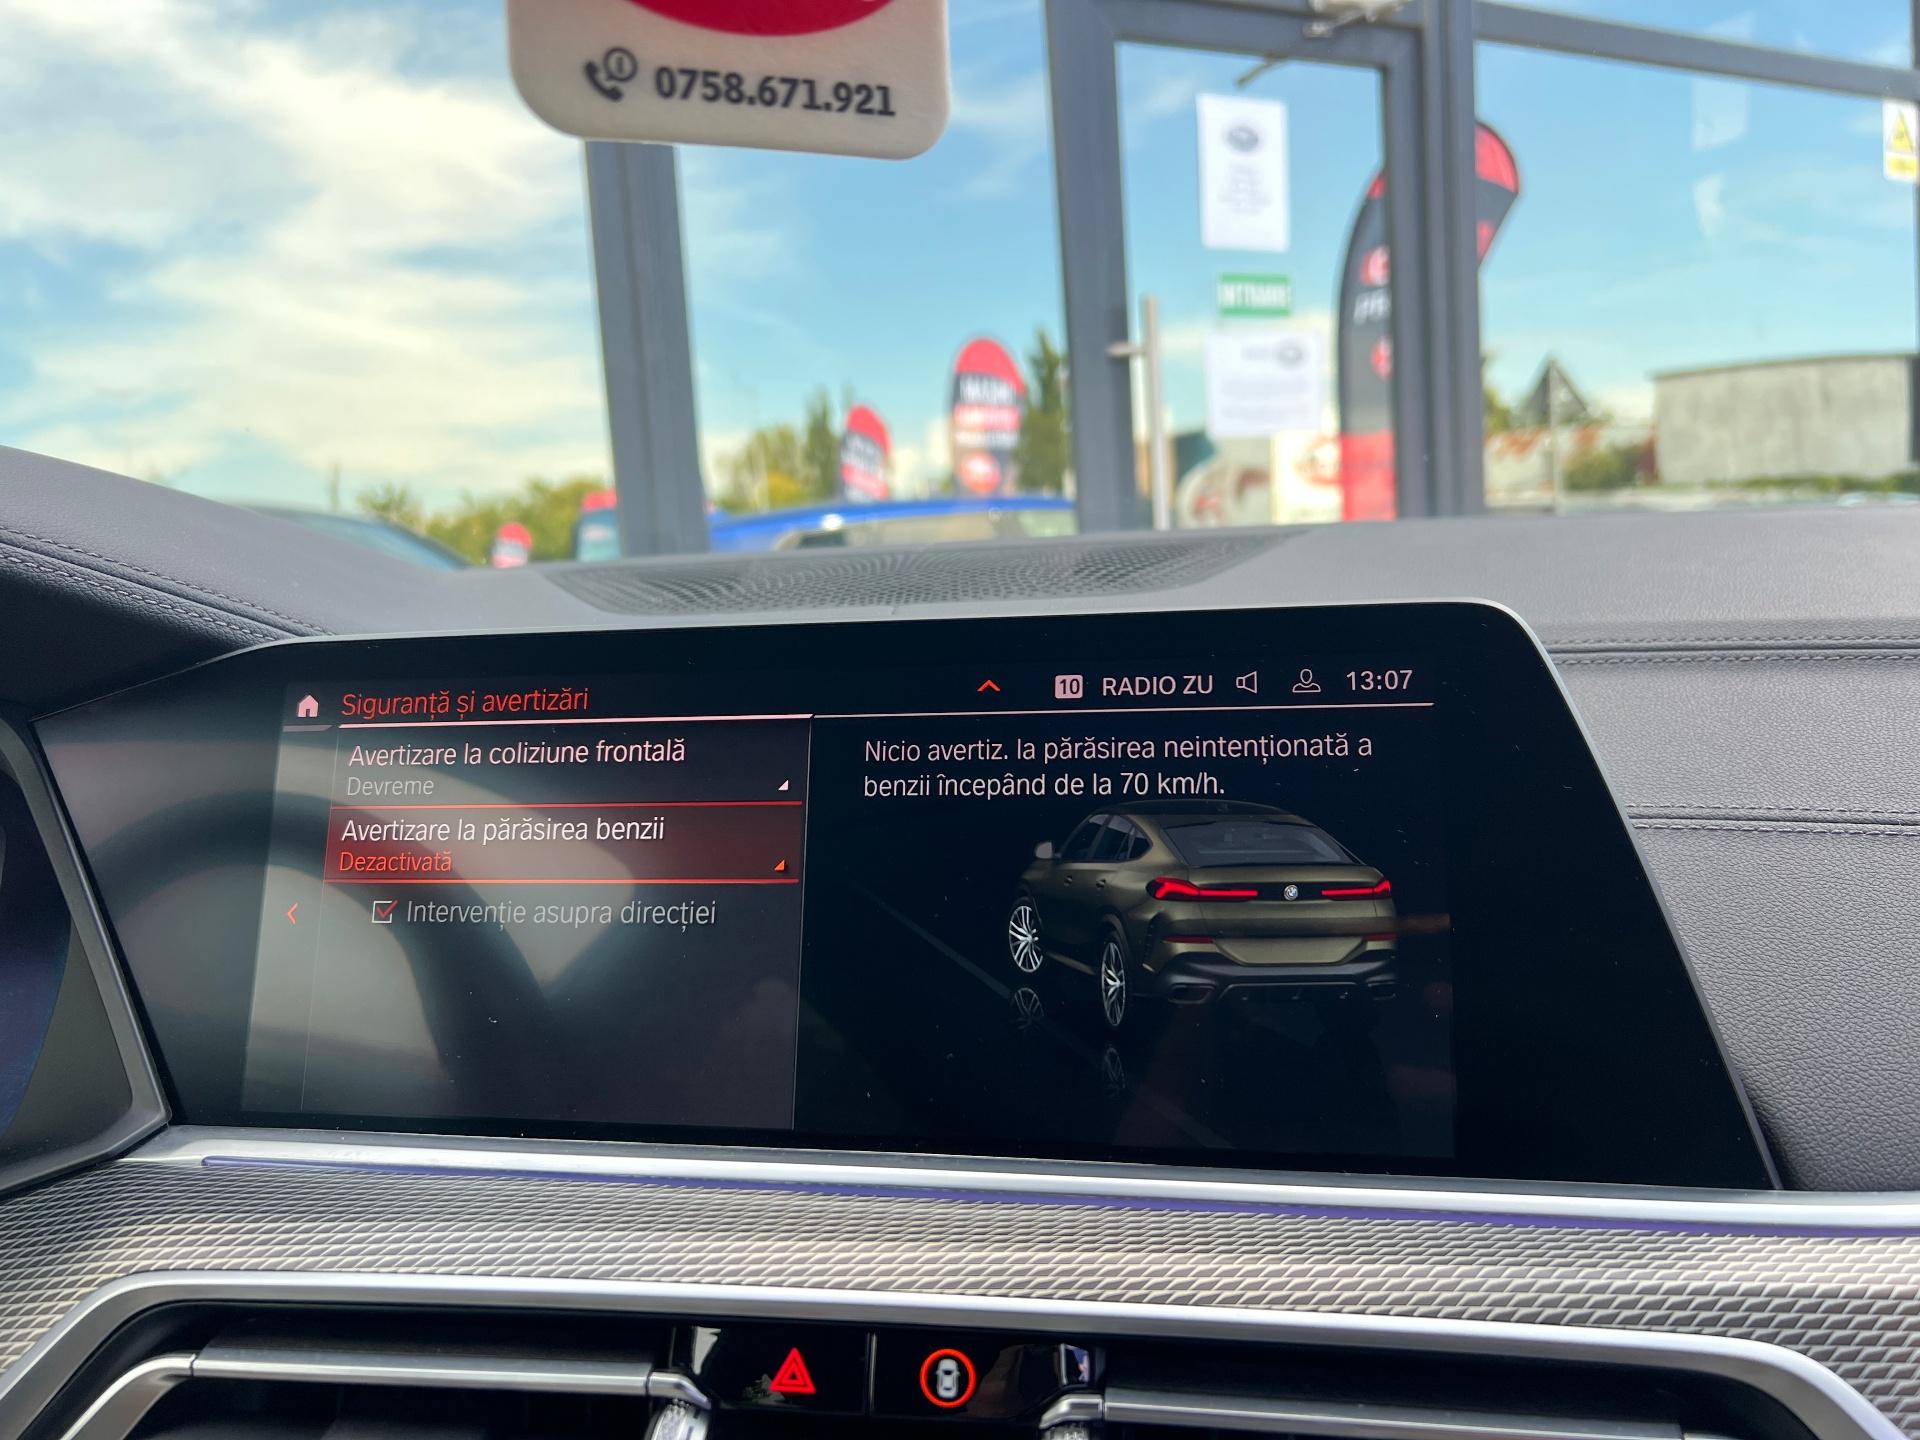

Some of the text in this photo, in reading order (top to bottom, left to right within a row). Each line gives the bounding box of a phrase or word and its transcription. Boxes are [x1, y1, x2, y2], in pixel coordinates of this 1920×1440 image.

[655, 66, 896, 117] 0758.671.921
[1058, 678, 1081, 696] 10
[1102, 675, 1214, 696] RADIO ZU
[1346, 670, 1413, 692] 13:07
[341, 687, 590, 721] Siguranță și avertizări
[349, 738, 686, 767] Avertizare la coliziune frontală
[864, 733, 1373, 765] Nicio avertiz. la părăsirea neintenționată a
[347, 776, 435, 797] Devreme
[863, 771, 1225, 801] benzii începând de la 70 km/h.
[341, 816, 665, 846] Avertizare la părăsirea benzii
[339, 851, 453, 873] Dezactivată
[406, 900, 716, 931] Intervenție asupra direcției
